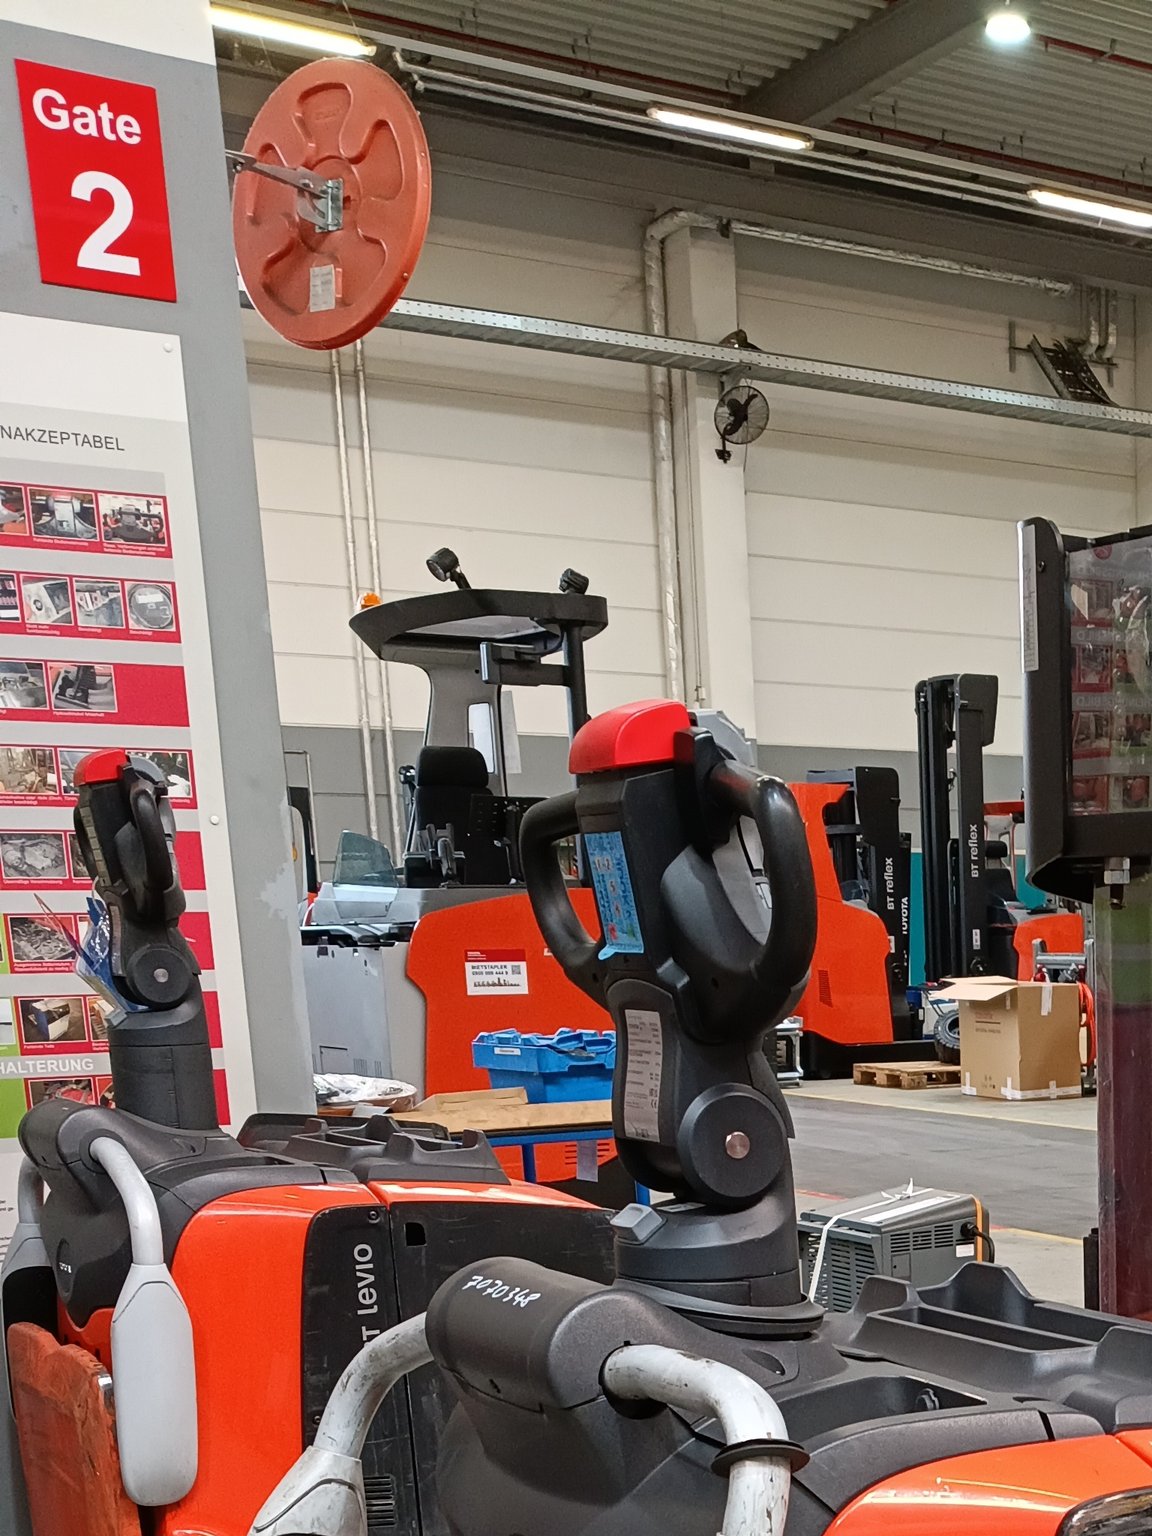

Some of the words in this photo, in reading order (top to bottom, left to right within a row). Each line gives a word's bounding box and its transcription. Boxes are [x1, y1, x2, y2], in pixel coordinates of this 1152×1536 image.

[32, 87, 142, 145] Gate
[70, 170, 141, 277] 2
[0, 424, 125, 451] NAKZEPTABEL
[968, 824, 978, 860] reflex
[883, 857, 894, 893] reflex
[971, 864, 979, 878] BT
[887, 896, 895, 910] BT
